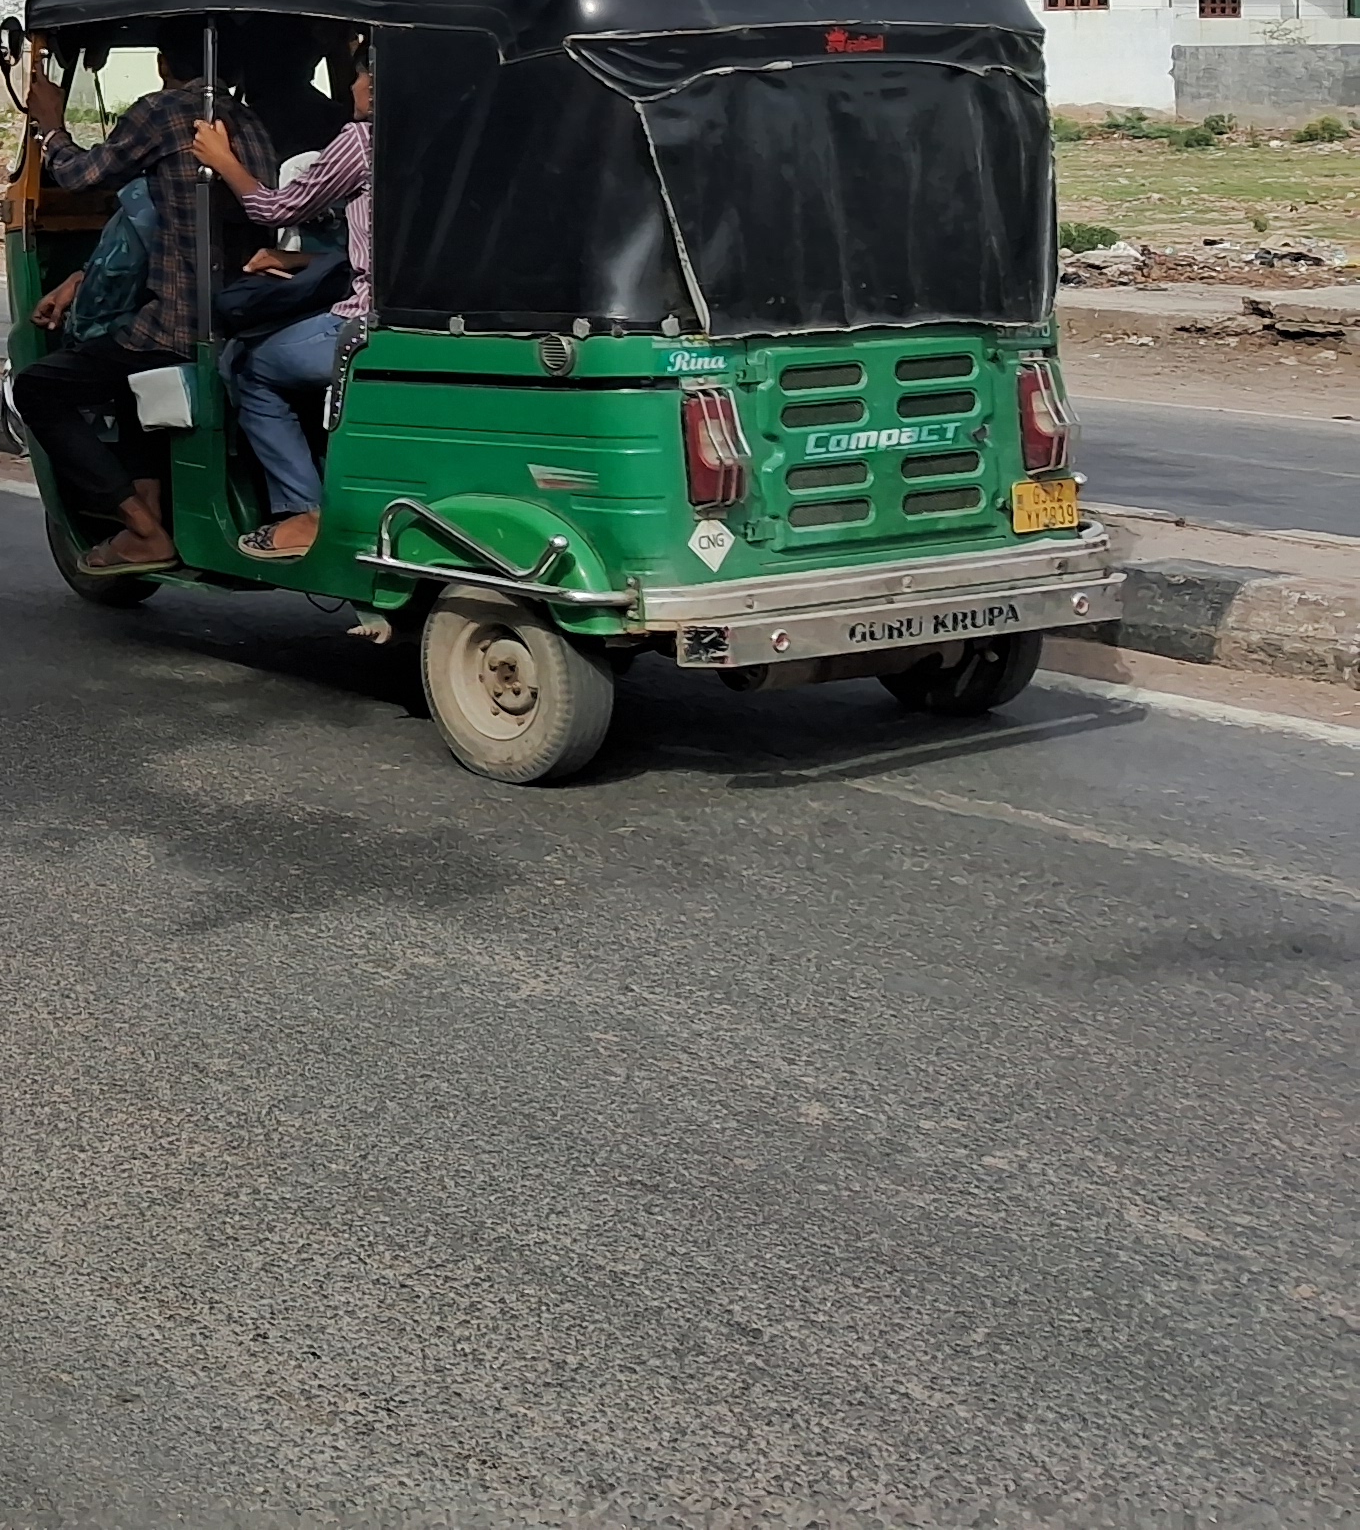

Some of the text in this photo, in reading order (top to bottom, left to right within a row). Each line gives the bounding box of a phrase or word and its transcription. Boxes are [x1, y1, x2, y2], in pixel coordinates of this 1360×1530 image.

[665, 349, 727, 374] Rina
[697, 532, 726, 552] CNG
[848, 603, 1022, 644] GURU KRUPA
